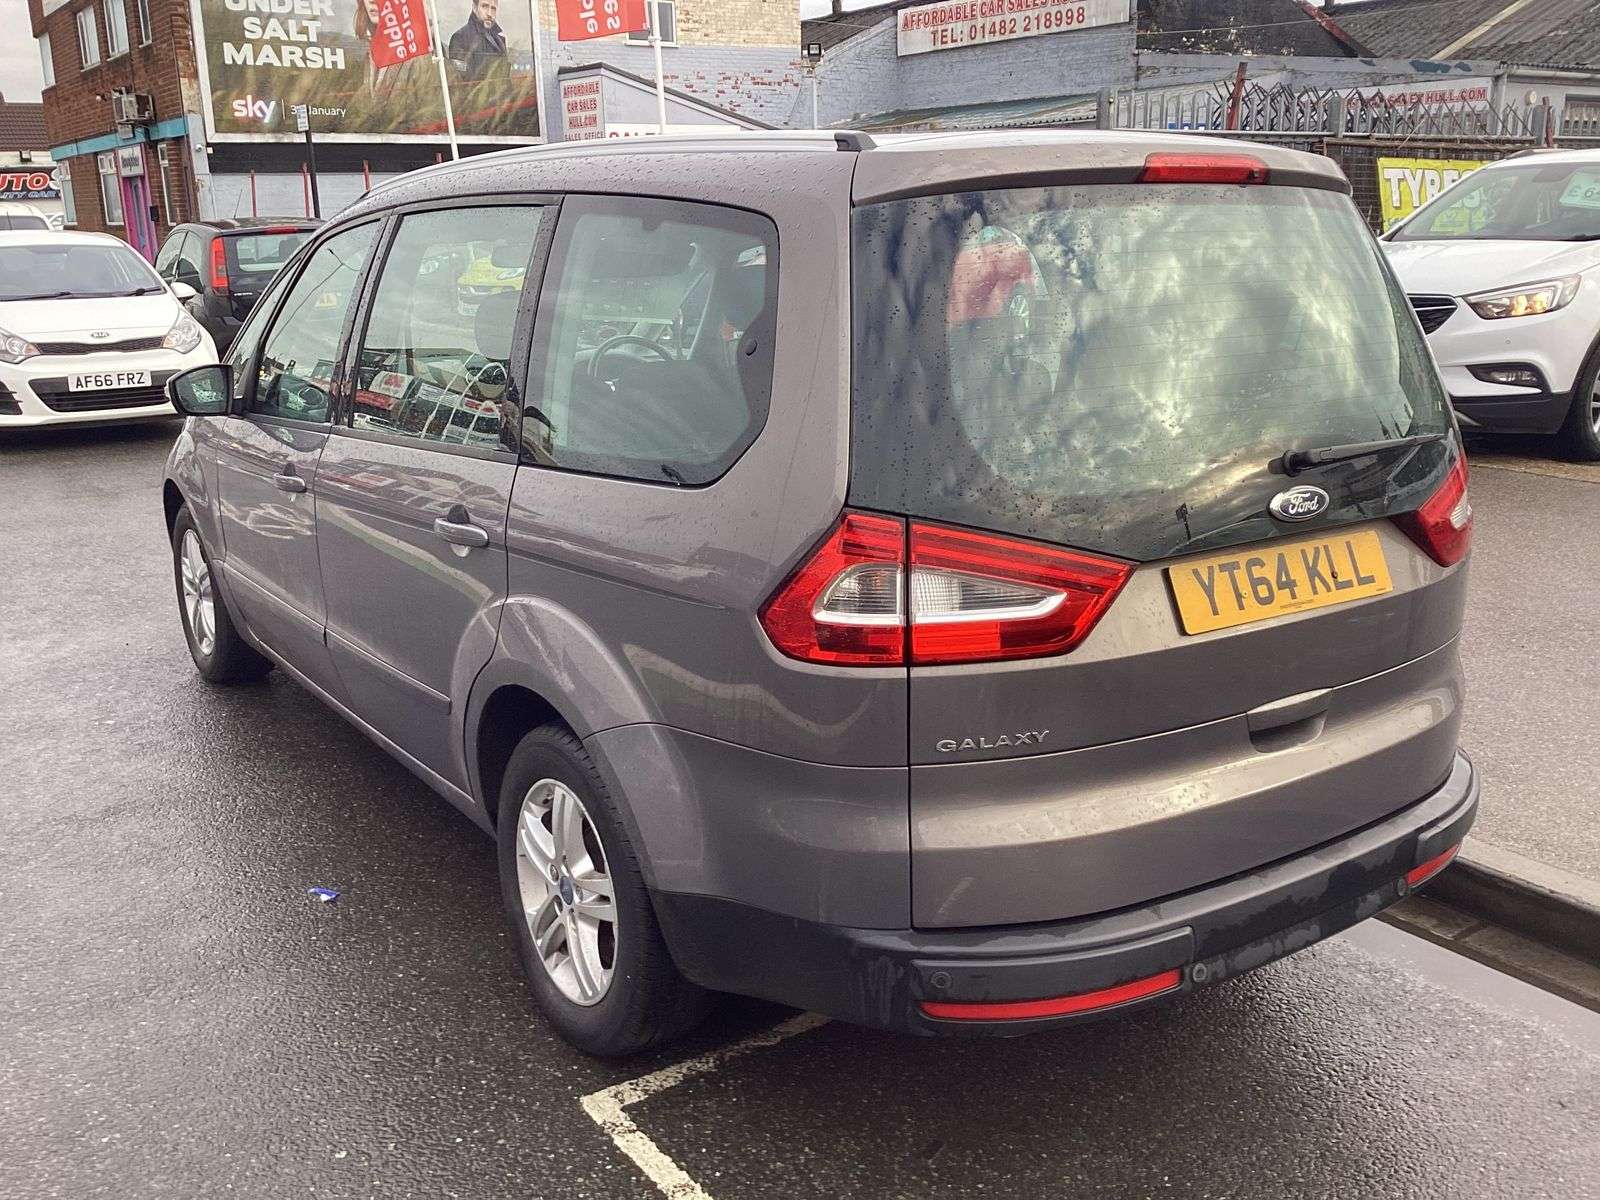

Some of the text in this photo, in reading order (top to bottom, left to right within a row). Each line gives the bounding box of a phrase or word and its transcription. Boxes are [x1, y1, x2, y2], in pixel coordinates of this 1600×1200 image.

[225, 0, 335, 16] UNDER
[902, 5, 977, 31] AFFORDABLE
[979, 0, 1004, 17] CAR
[243, 16, 322, 42] SALT
[931, 6, 1086, 46] TEL: 01482 218998
[223, 42, 346, 70] MARSH
[563, 82, 600, 99] AFFORDABLE
[232, 94, 277, 123] sky
[567, 98, 598, 113] CAR SALES
[1383, 168, 1474, 207] TYRE
[75, 372, 146, 389] AF66 FRZ
[1288, 492, 1320, 514] Ford
[1191, 540, 1376, 617] YT64 KLL
[935, 730, 1050, 752] GALAXY
